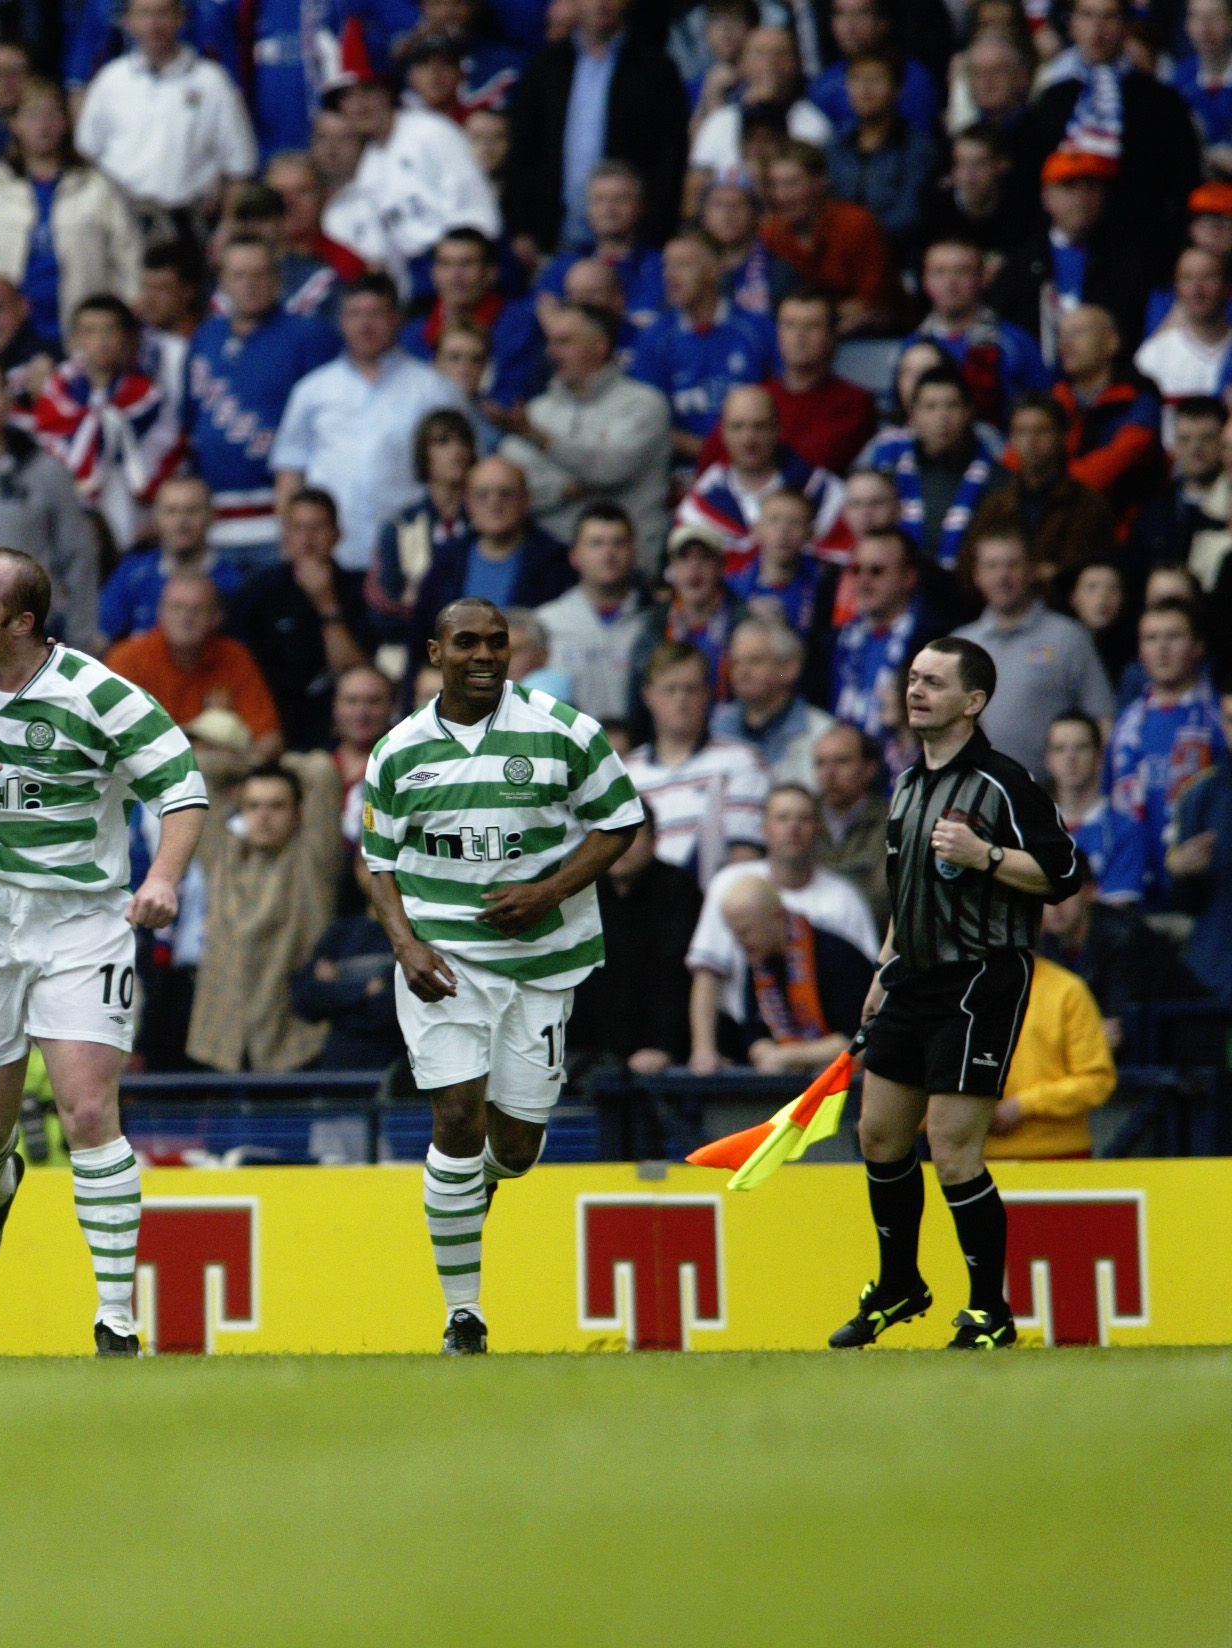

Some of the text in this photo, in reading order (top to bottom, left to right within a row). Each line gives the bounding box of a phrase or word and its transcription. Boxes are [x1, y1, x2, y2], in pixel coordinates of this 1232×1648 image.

[423, 825, 524, 862] ntl:
[99, 962, 134, 1010] 10
[135, 1195, 260, 1354] T
[577, 1192, 726, 1352] T
[1003, 1188, 1150, 1347] T
